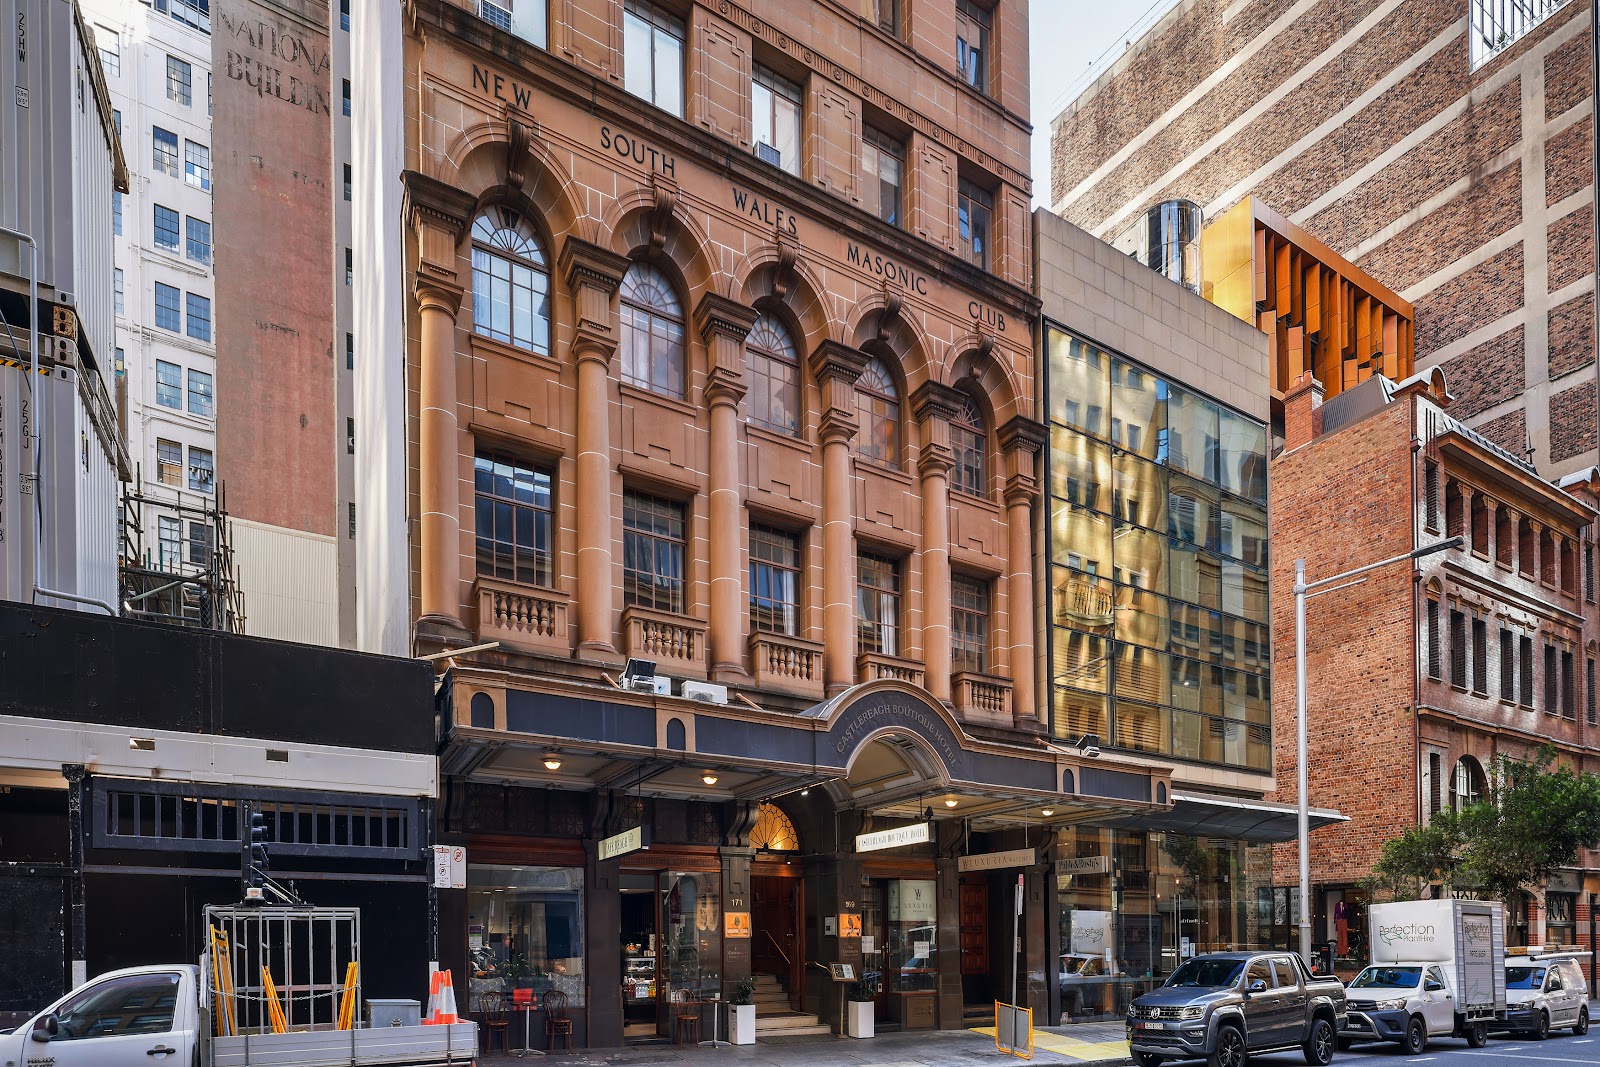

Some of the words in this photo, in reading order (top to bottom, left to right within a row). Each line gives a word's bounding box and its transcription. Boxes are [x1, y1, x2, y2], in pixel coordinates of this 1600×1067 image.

[18, 12, 26, 63] 25HW
[472, 63, 532, 111] NEW
[600, 125, 675, 178] SOUTH
[732, 187, 798, 236] WALES
[847, 242, 928, 296] MASONIC
[968, 300, 1006, 332] CLUB
[836, 704, 891, 753] CASTLEREAGH
[892, 704, 935, 732] BOUTIQUE
[934, 729, 958, 768] HOTEL
[969, 856, 1007, 867] LUXURIA
[731, 898, 743, 906] 171
[1379, 923, 1435, 936] Perfection
[1403, 934, 1435, 942] PlantHire
